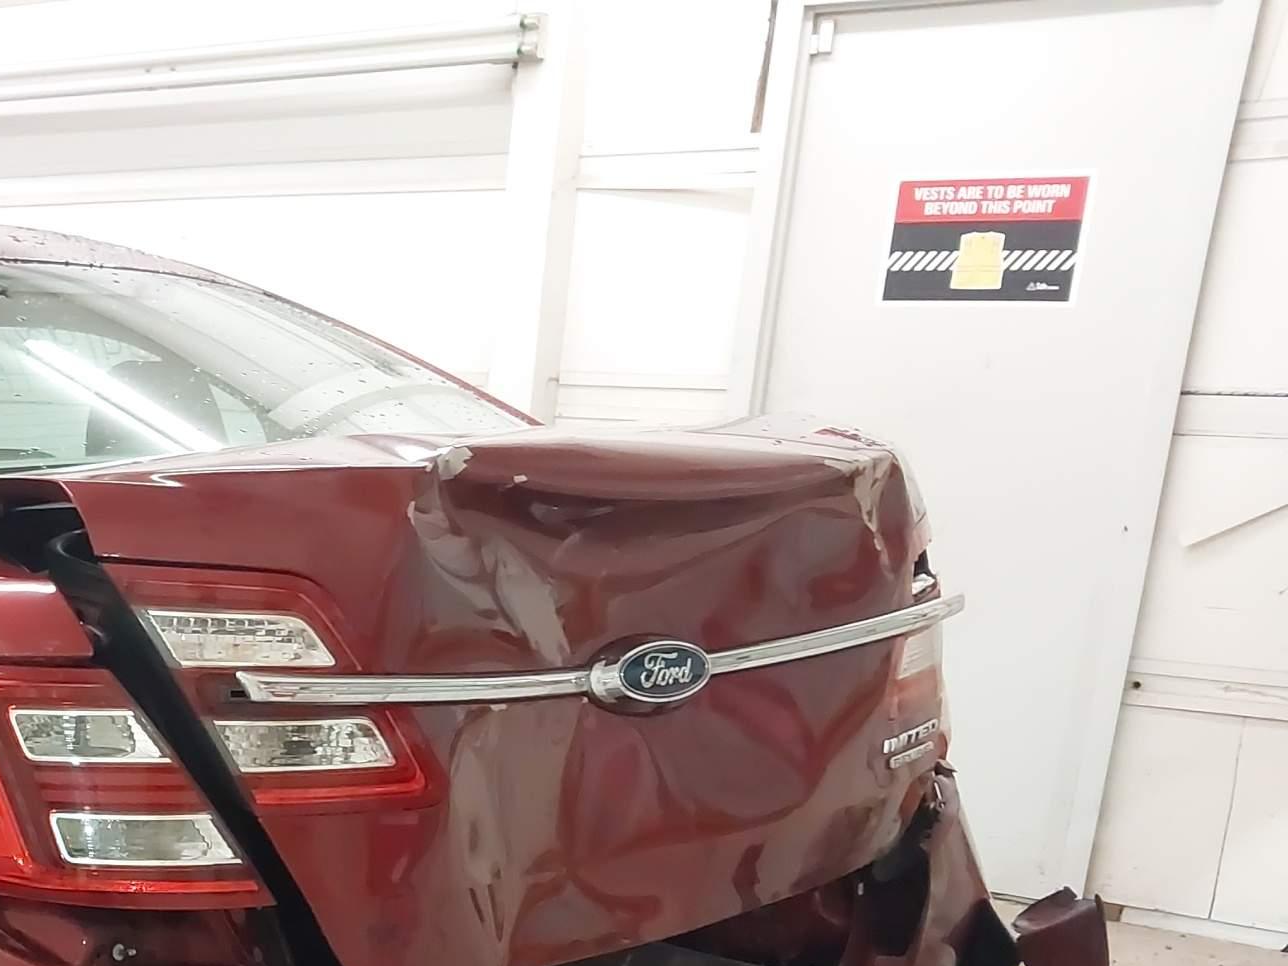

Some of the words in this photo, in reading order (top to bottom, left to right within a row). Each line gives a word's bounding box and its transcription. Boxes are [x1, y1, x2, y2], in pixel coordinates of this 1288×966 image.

[914, 187, 956, 201] VESTS
[957, 186, 984, 200] ARE
[986, 185, 1004, 199] TO
[1006, 185, 1025, 199] BE
[1027, 184, 1071, 198] WORN
[924, 201, 978, 216] BEYOND
[981, 201, 1011, 215] THIS
[1013, 200, 1056, 214] POINT
[639, 652, 694, 689] Ford
